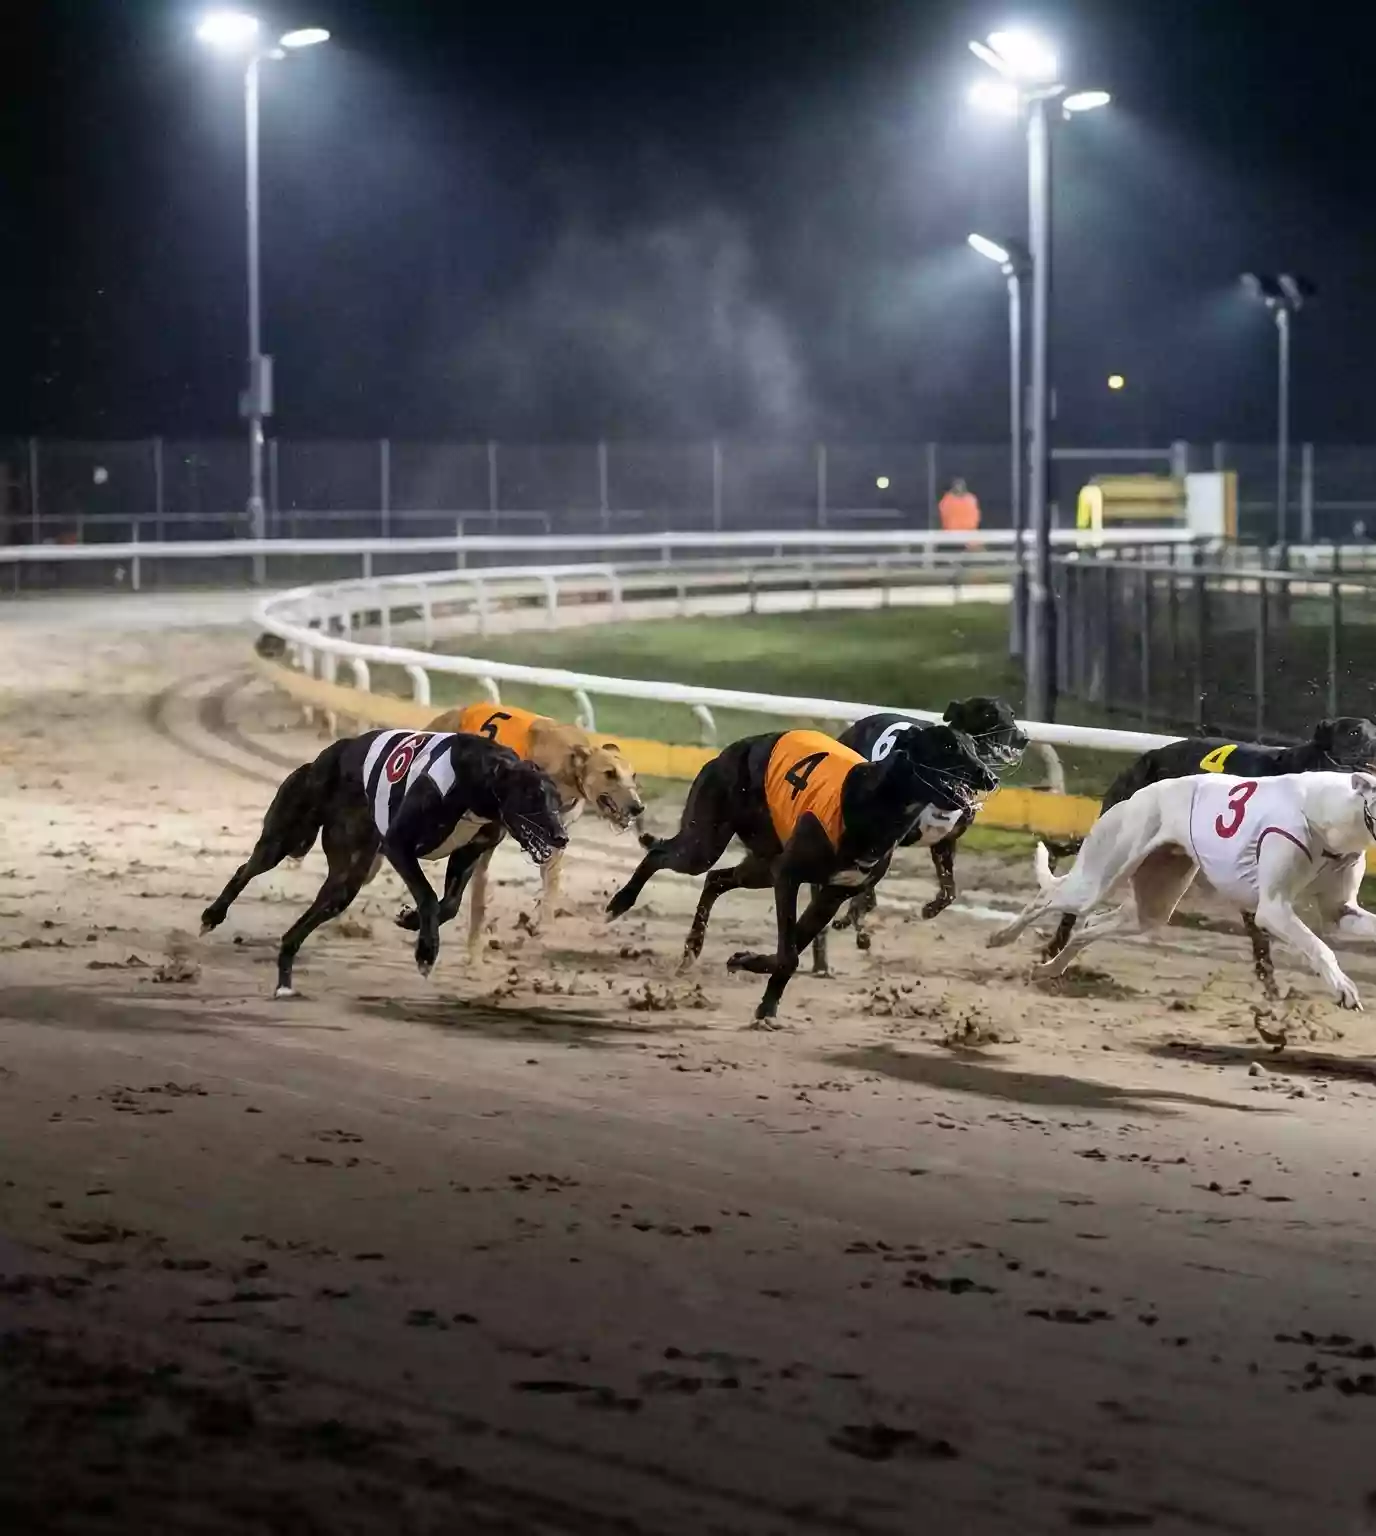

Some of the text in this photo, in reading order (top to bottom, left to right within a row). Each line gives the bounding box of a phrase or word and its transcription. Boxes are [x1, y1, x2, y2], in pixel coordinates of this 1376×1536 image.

[480, 711, 512, 741] 5
[871, 721, 916, 763] 6
[385, 736, 426, 784] 6
[784, 751, 830, 801] 4
[1199, 744, 1239, 774] 4
[1215, 781, 1258, 839] 3
